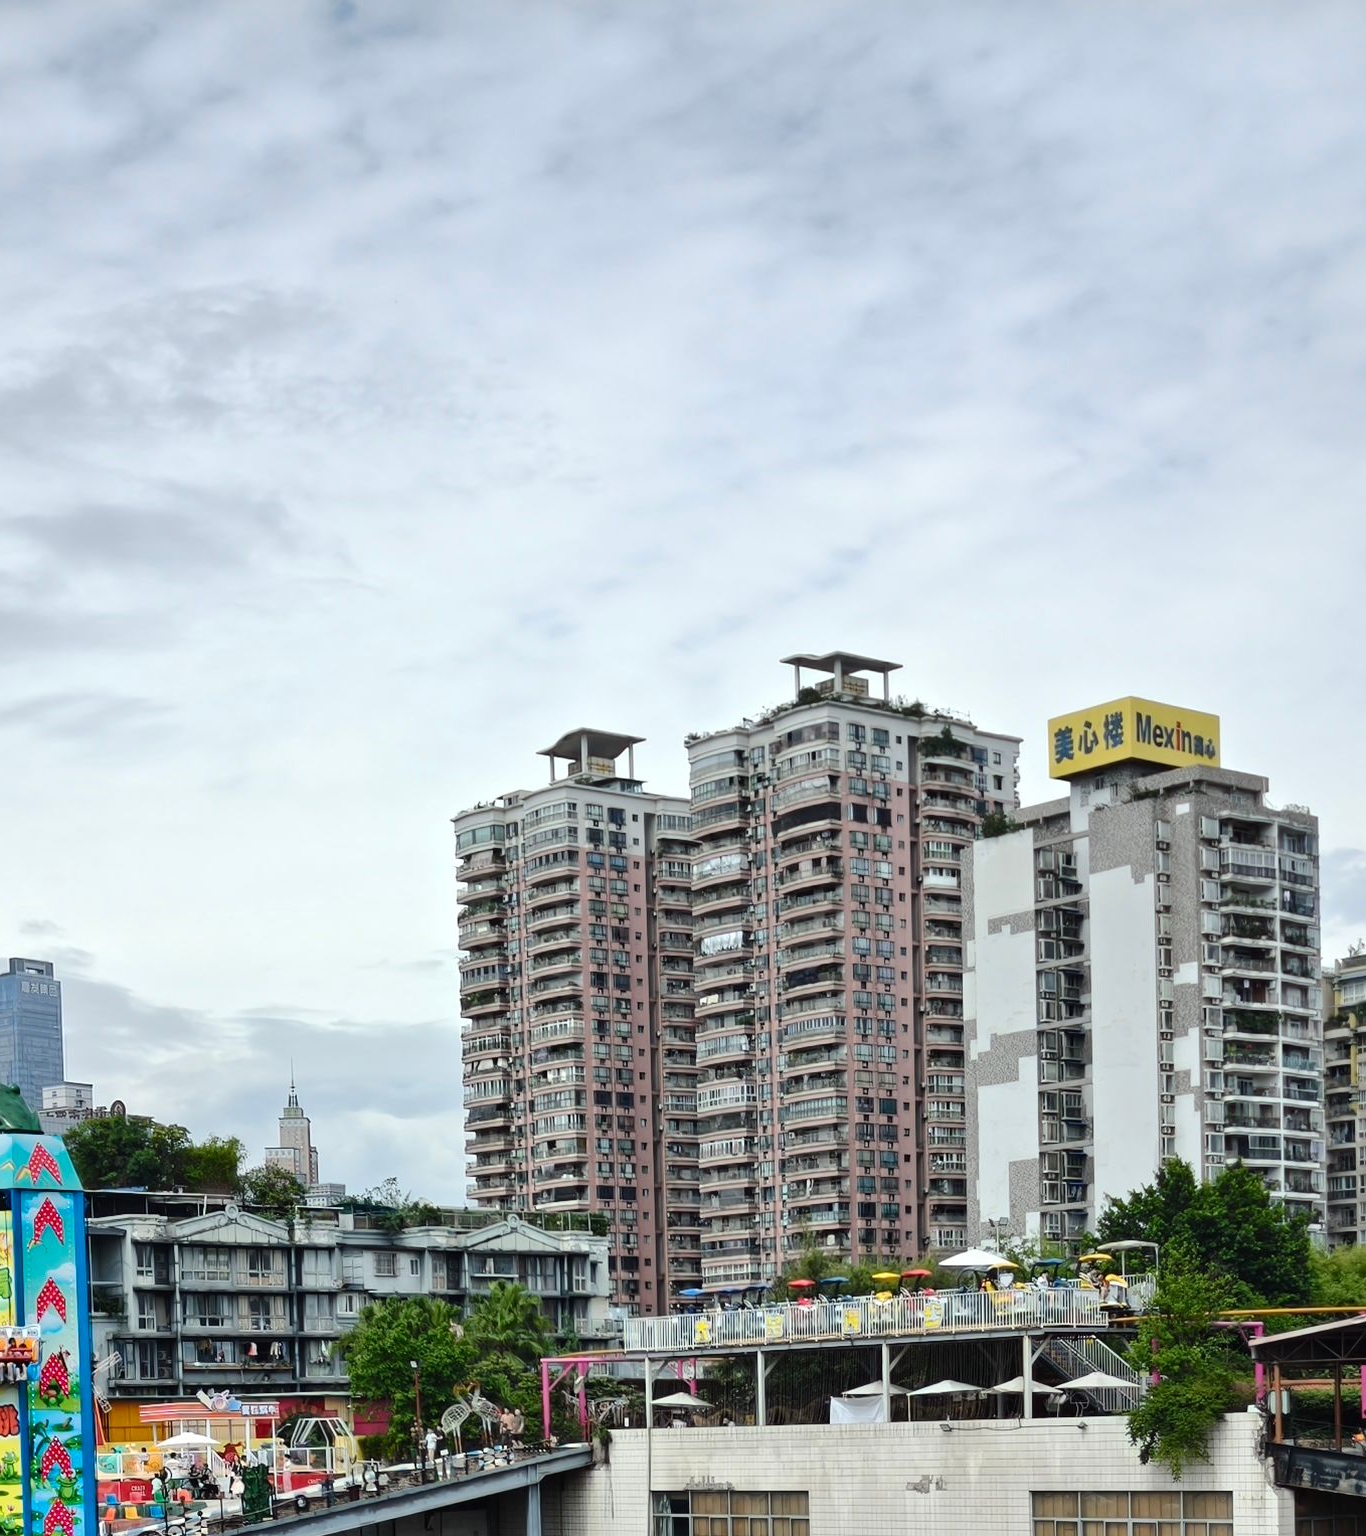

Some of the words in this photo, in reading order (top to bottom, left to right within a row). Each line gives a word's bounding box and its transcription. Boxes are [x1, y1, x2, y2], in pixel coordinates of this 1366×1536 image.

[1054, 711, 1124, 764] 美心楼
[1136, 711, 1192, 754] Mexin
